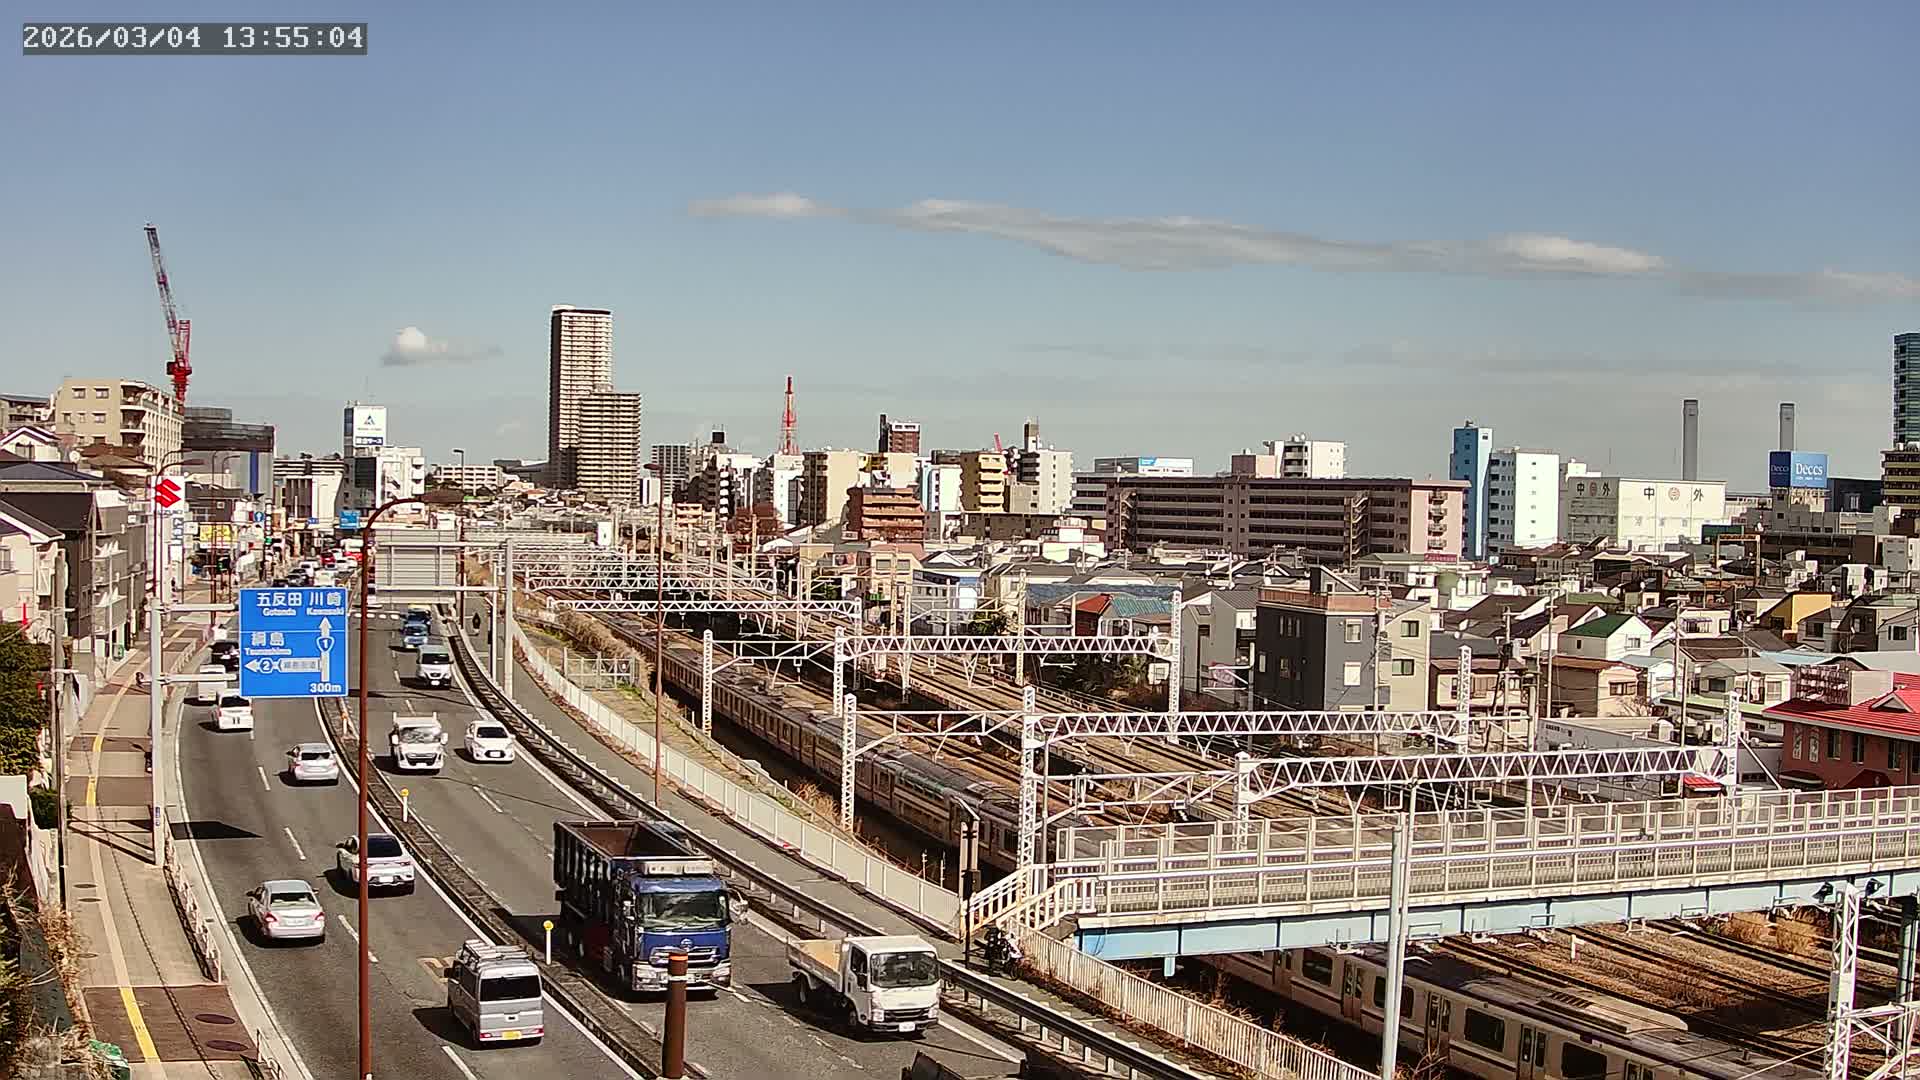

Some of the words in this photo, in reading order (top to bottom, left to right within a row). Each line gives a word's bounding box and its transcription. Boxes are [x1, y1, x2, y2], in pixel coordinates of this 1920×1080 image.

[1795, 462, 1823, 476] Deccs
[1643, 486, 1655, 501] 中
[256, 592, 303, 607] 五反田
[309, 591, 342, 607] 川崎
[322, 639, 328, 648] 1
[262, 661, 270, 670] 2
[309, 682, 342, 693] 300m
